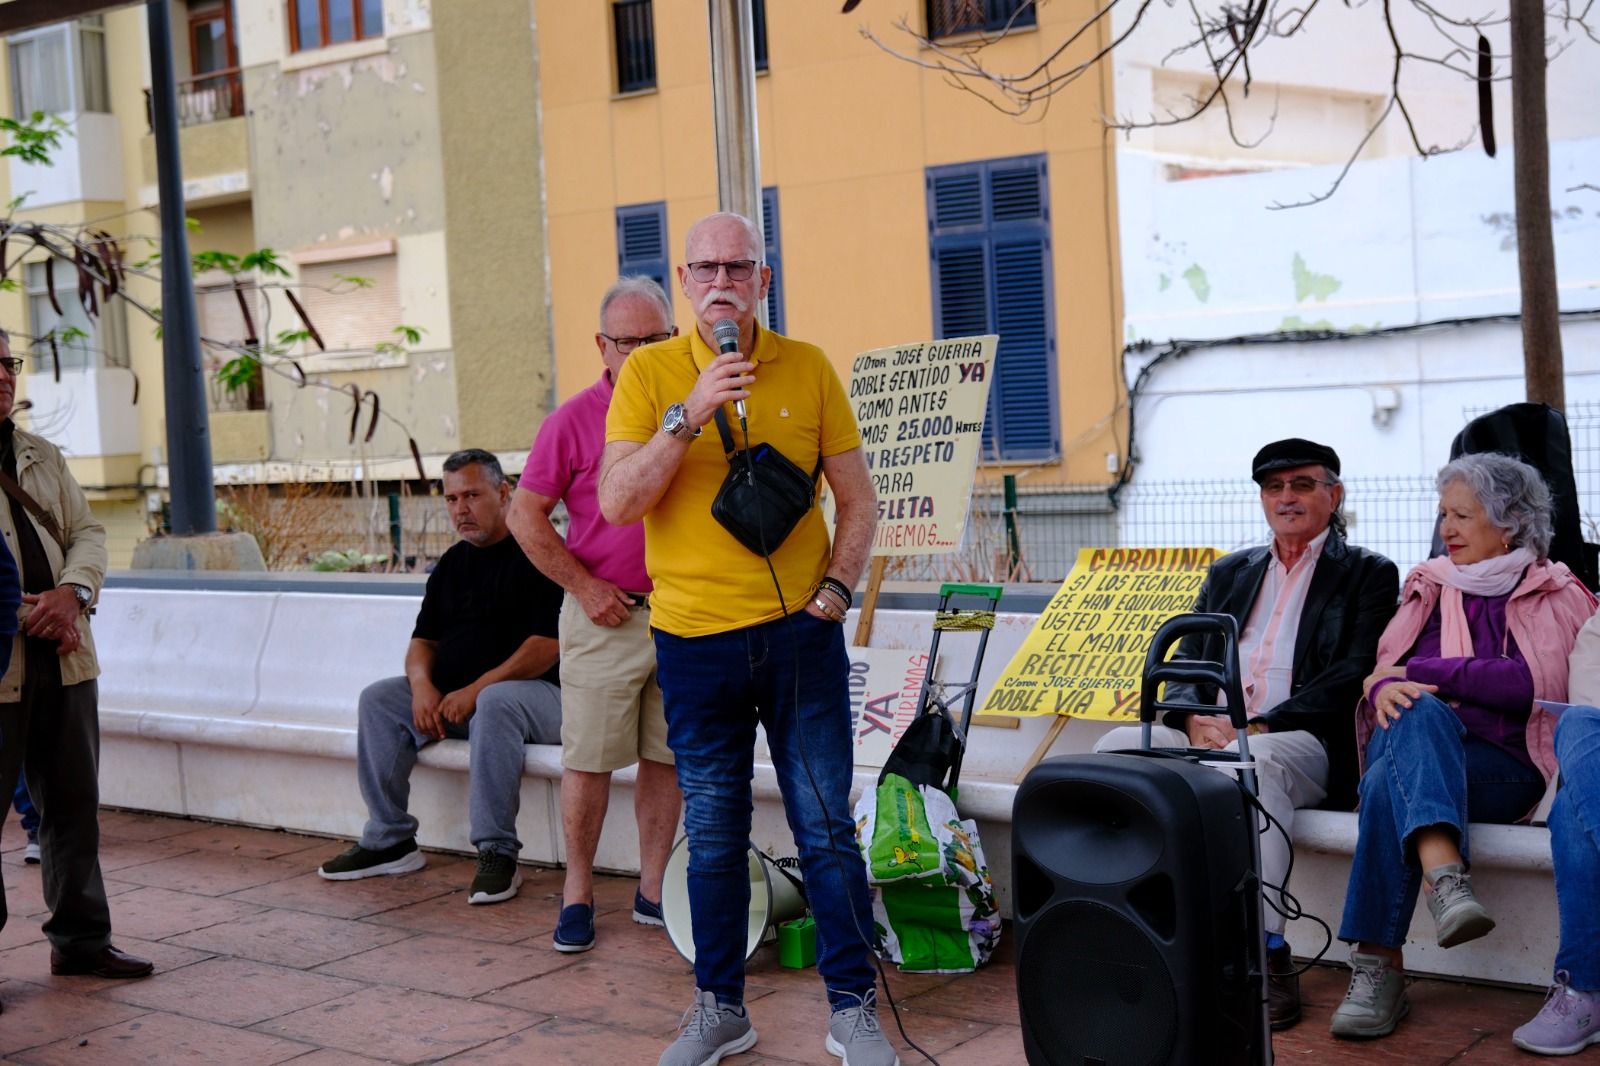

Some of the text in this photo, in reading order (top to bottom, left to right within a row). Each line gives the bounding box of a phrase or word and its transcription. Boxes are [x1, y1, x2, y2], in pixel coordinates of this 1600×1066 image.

[892, 343, 924, 366] JOSÉ
[927, 342, 982, 362] GUERRA
[850, 374, 886, 398] DOBLE
[896, 415, 954, 442] 25.000
[1089, 548, 1216, 573] CAROLINA
[1096, 574, 1130, 592] LOS
[1129, 572, 1203, 592] TÉCNICO
[1050, 592, 1197, 612] SE HAN EQUIVOCA
[1041, 612, 1167, 632] USTED TIENE
[1045, 633, 1070, 651] EL
[1020, 652, 1146, 677] RECTIFIQU
[1079, 677, 1136, 690] GUERRA
[984, 688, 1049, 712] DOBLE
